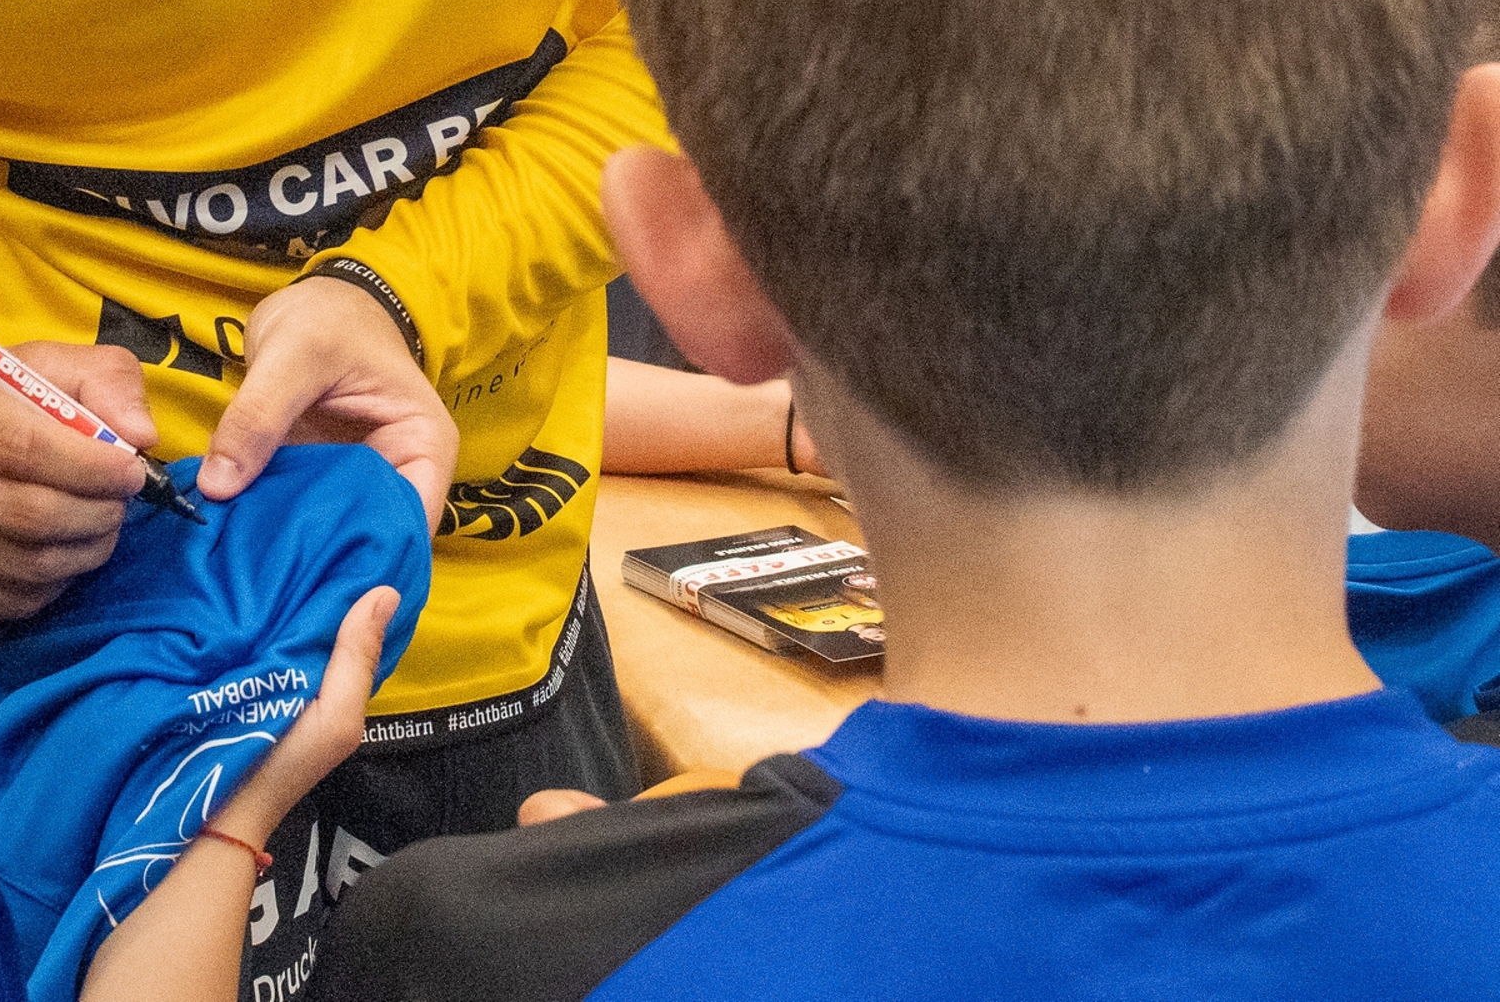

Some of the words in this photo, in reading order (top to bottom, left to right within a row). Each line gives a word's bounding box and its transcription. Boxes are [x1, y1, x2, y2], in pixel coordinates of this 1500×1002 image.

[269, 136, 413, 216] CAR
[188, 667, 309, 715] HANDBALL
[448, 700, 523, 731] #ächtbärn
